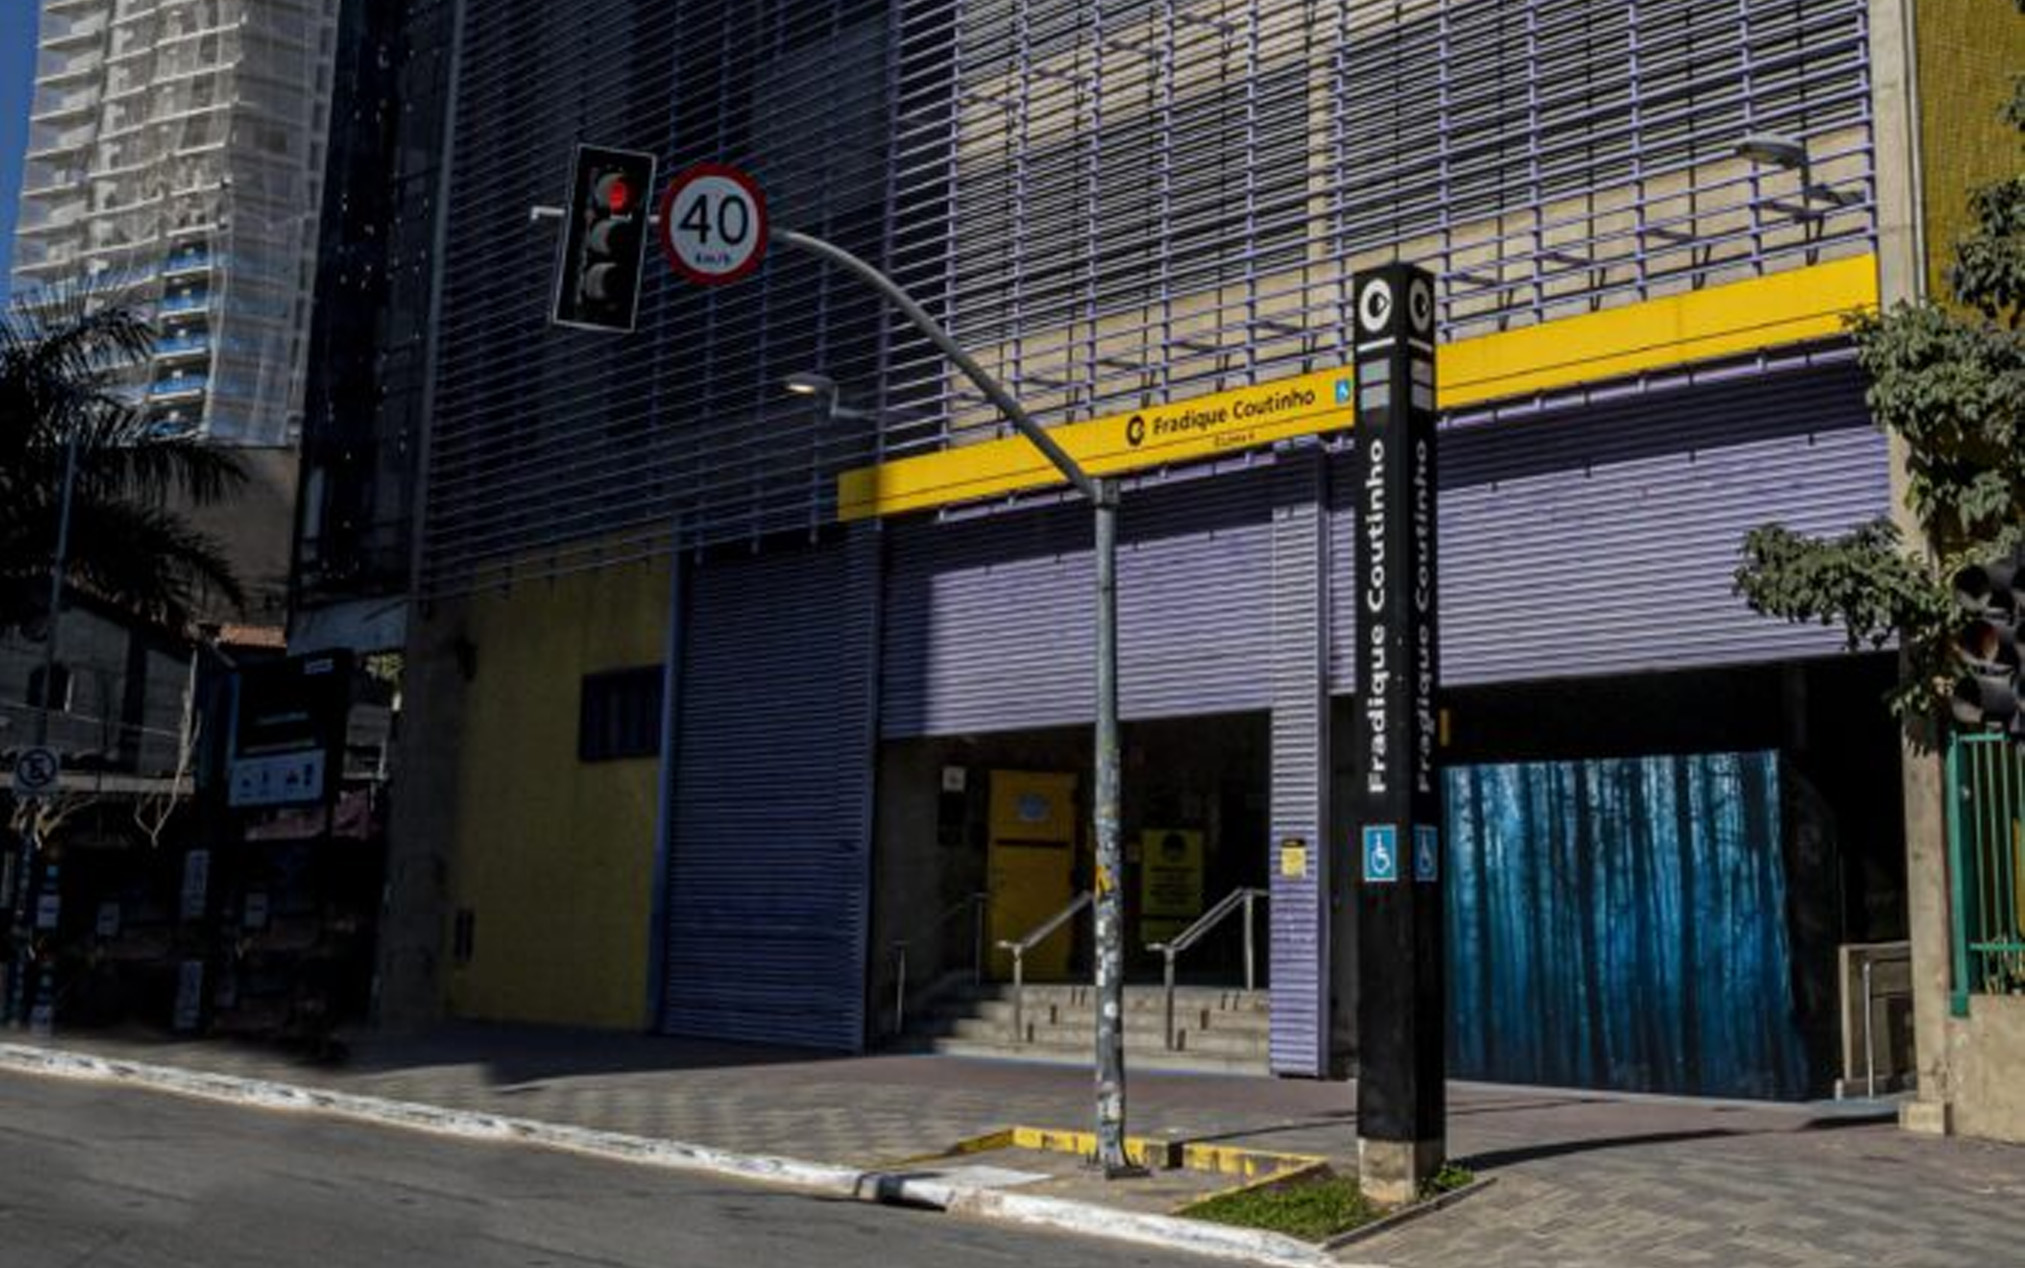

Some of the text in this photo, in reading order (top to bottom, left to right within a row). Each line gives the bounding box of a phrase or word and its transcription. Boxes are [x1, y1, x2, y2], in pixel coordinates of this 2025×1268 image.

[678, 194, 749, 245] 40
[1153, 389, 1316, 436] Fradique Coutinho
[1414, 438, 1430, 613] Coutinho
[1365, 438, 1391, 793] Fradique Coutinho
